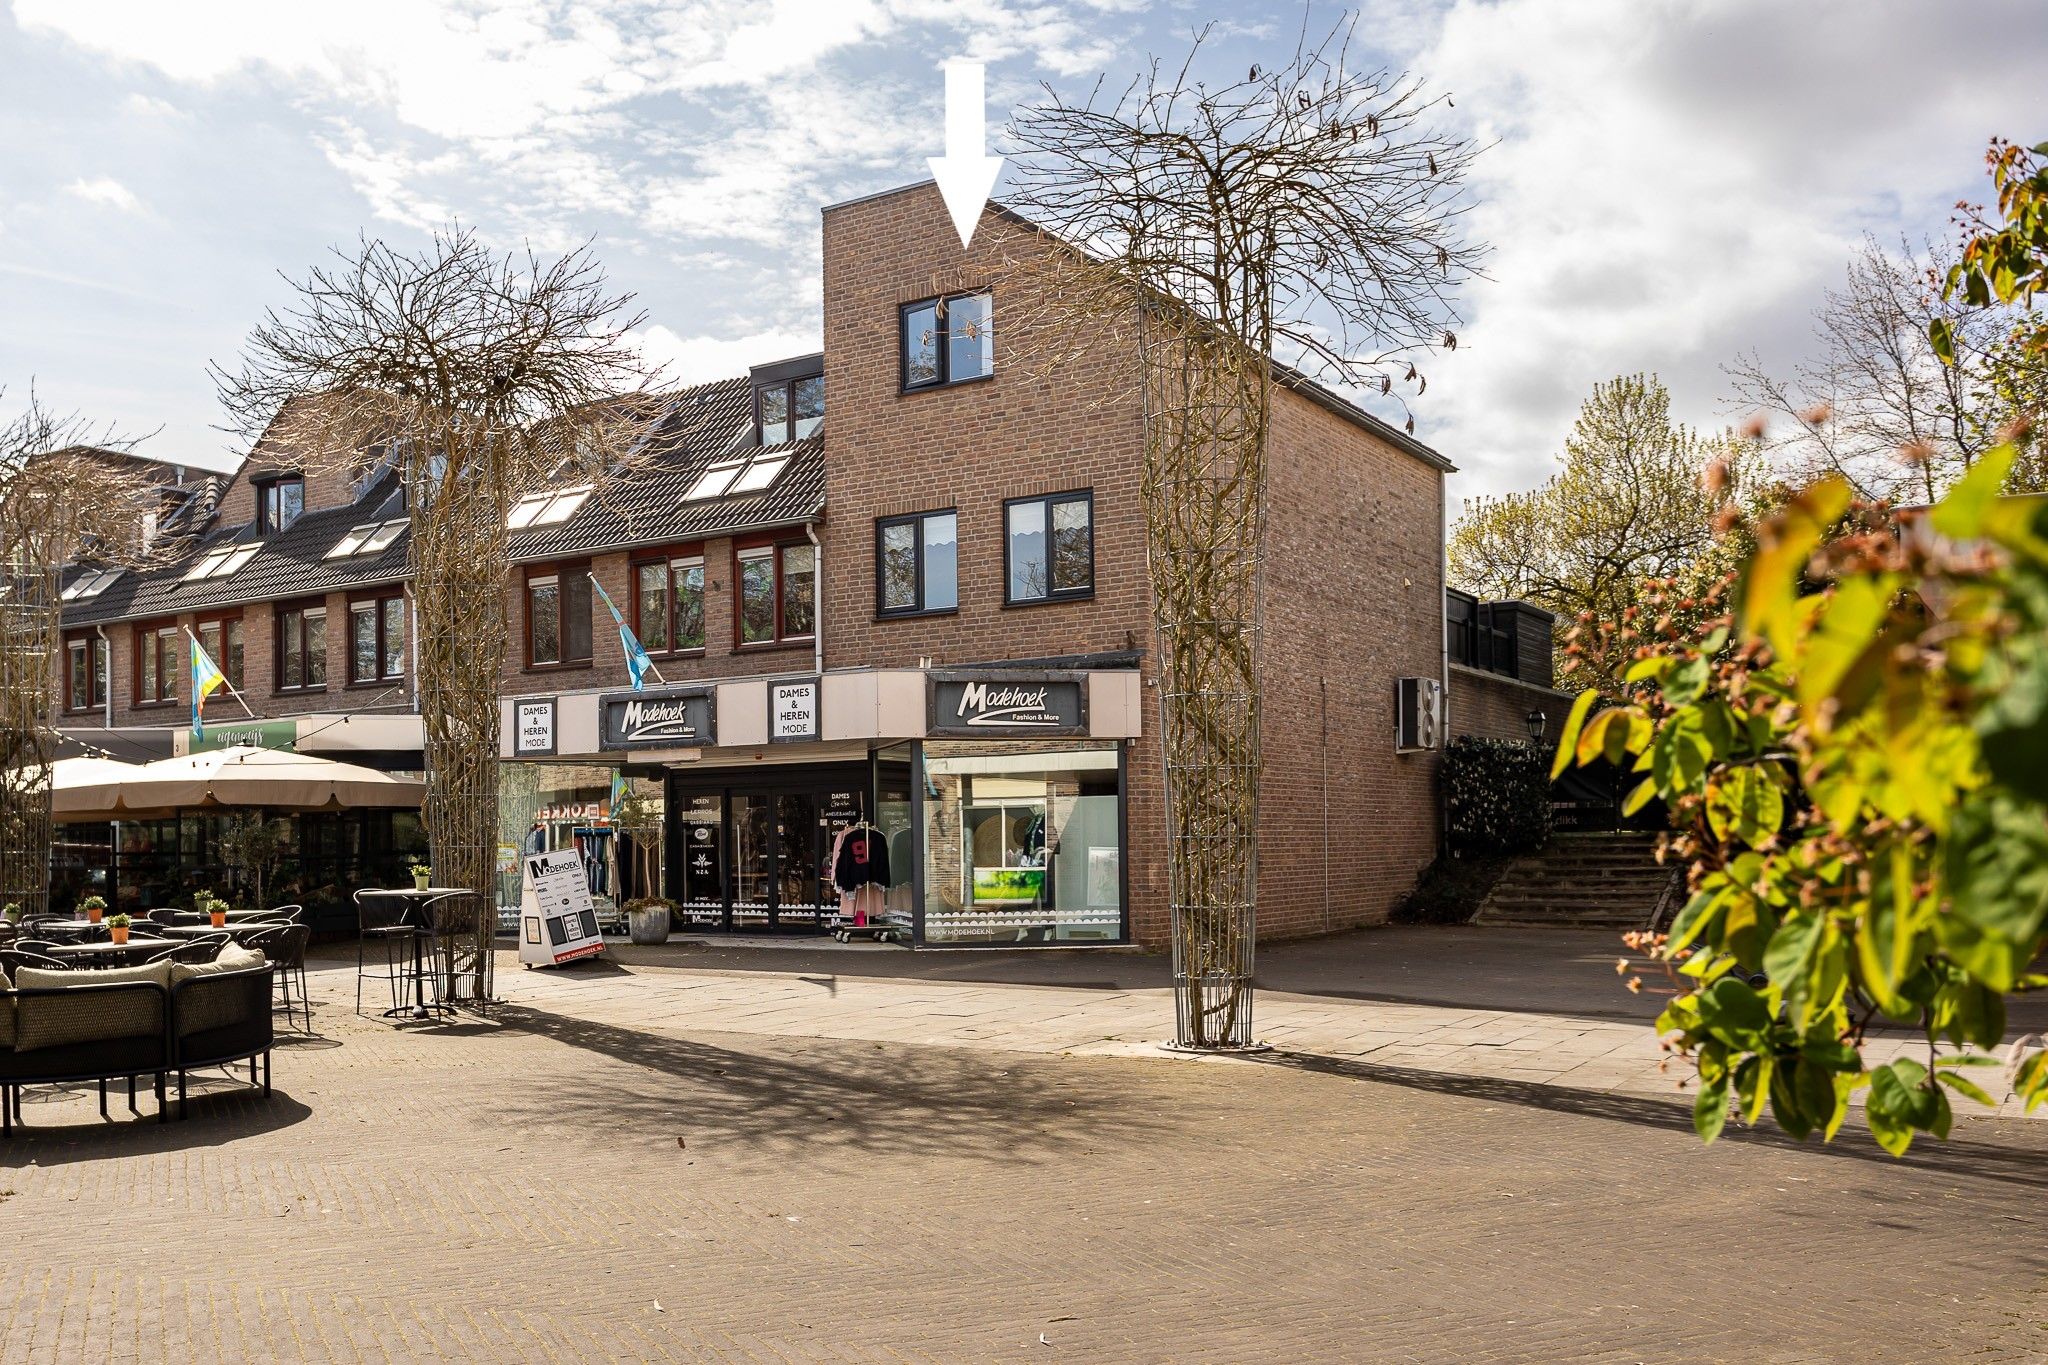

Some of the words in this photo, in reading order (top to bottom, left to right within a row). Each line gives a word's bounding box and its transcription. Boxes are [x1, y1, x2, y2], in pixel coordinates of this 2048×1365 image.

[780, 688, 810, 698] DAMES
[957, 682, 1047, 716] Modehoek
[791, 700, 798, 709] &
[523, 706, 548, 716] DAMES
[780, 711, 810, 721] HEREN
[532, 717, 539, 725] &
[621, 701, 686, 733] Modehoek
[523, 727, 548, 736] HEREN
[782, 724, 807, 734] MODE
[525, 739, 546, 747] MODE
[928, 928, 995, 937] WWW.MODEHOEK.NL
